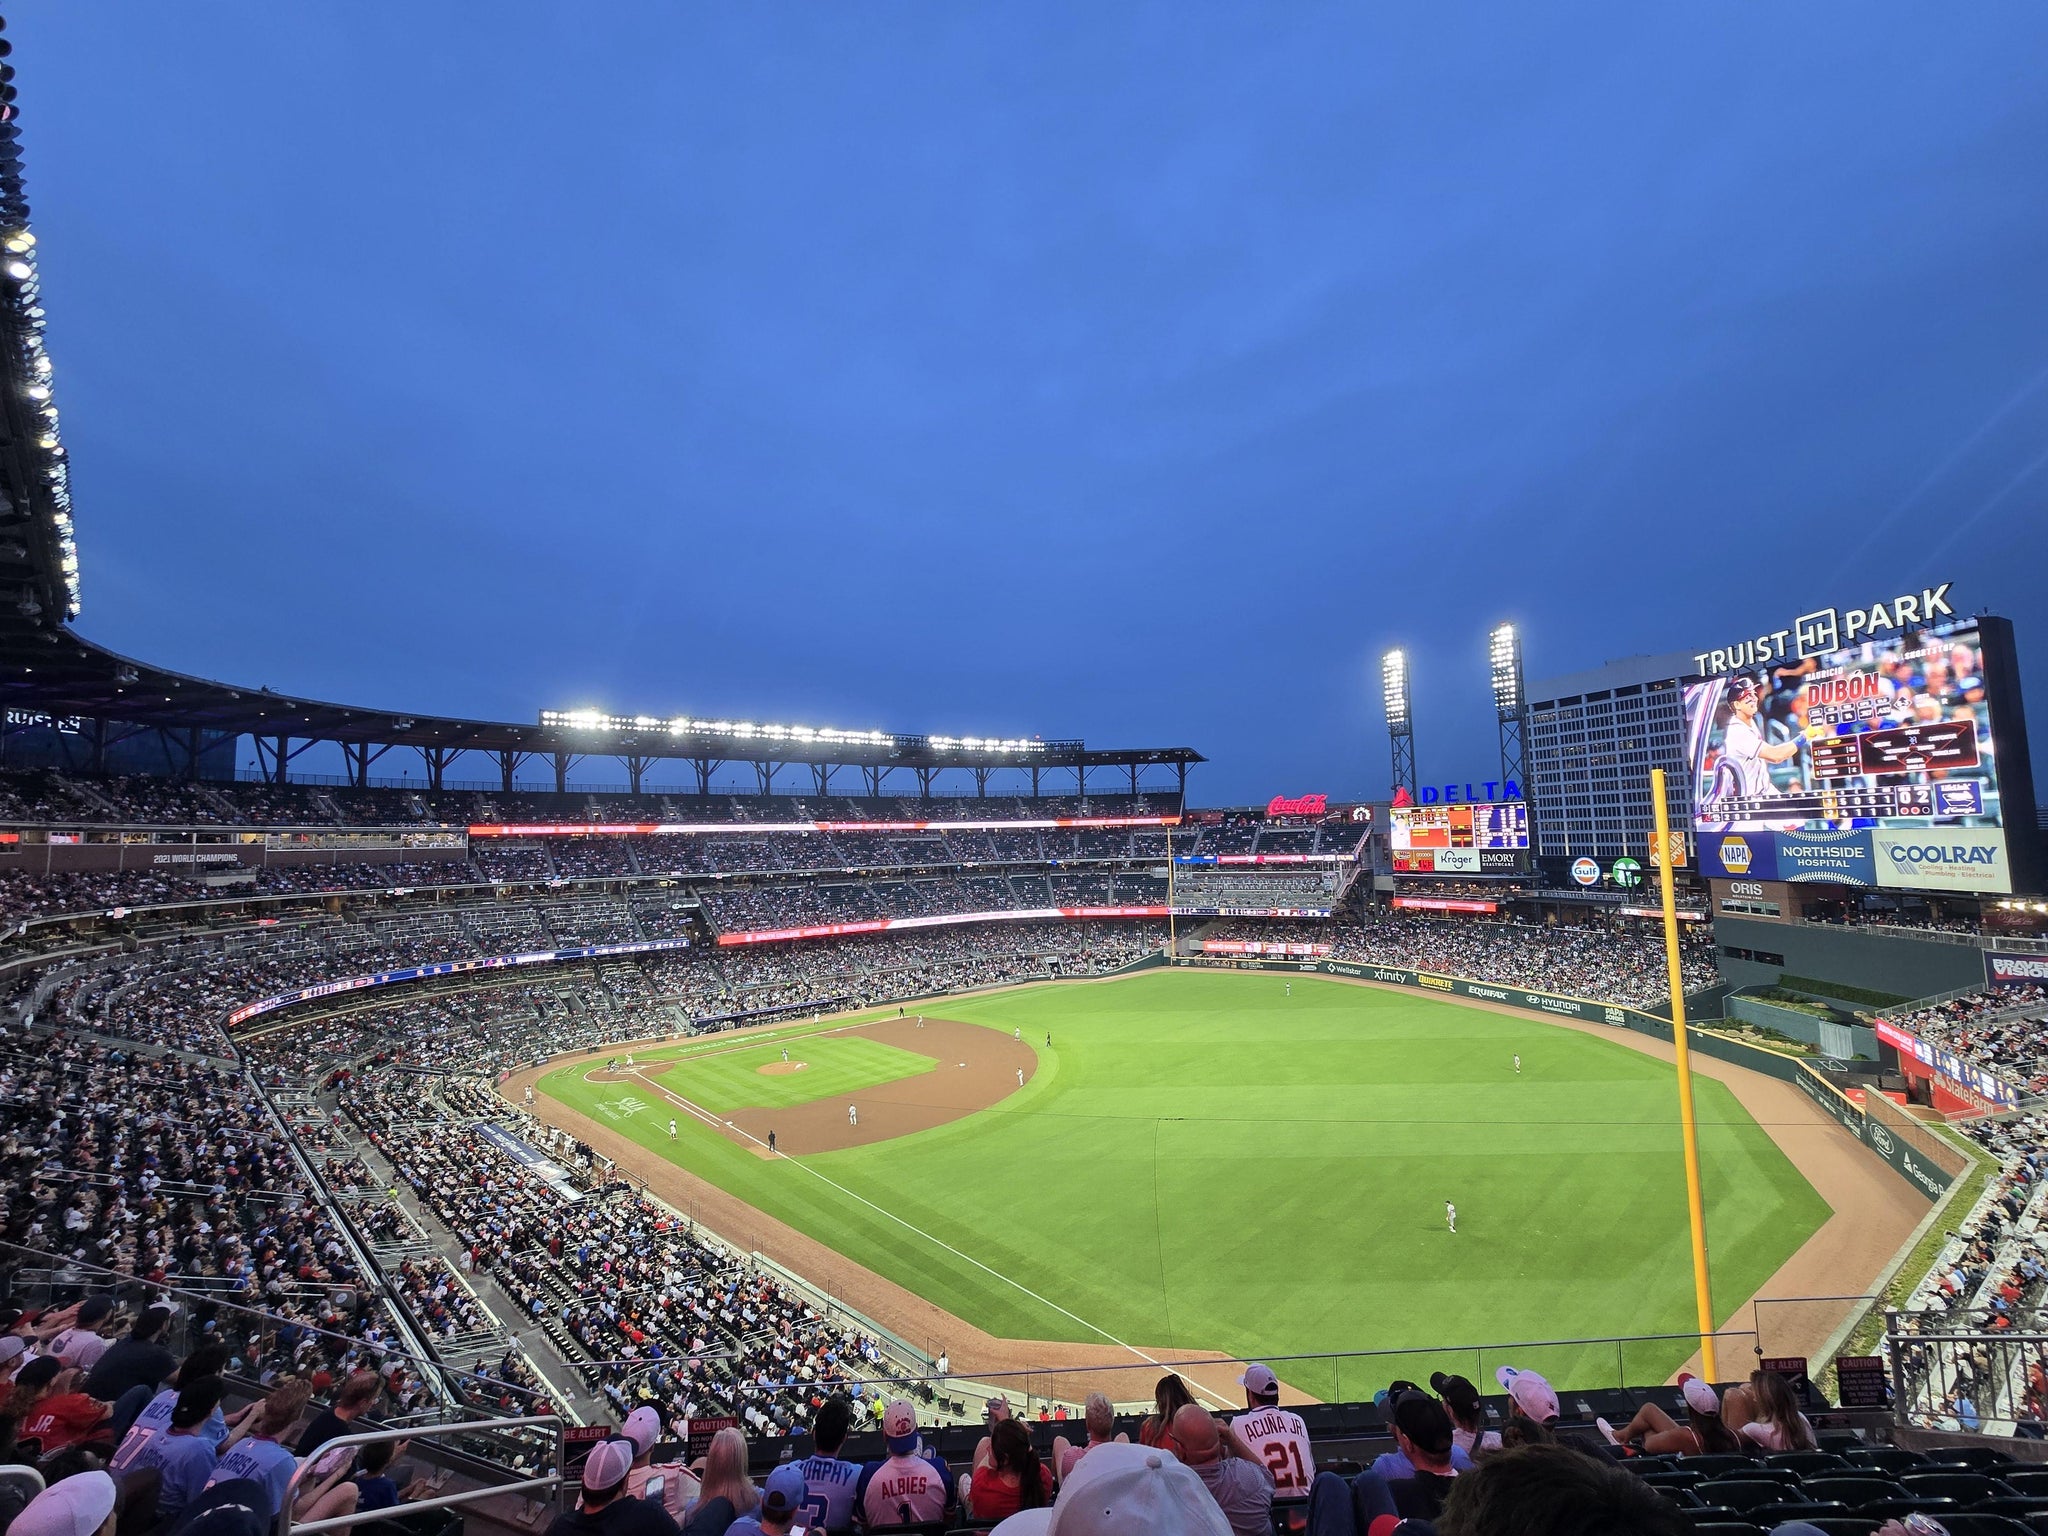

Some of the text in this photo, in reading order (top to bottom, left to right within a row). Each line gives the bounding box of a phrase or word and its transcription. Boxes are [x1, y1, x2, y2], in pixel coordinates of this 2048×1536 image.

[1694, 583, 1953, 677] TRUIST PARK
[1808, 669, 1880, 707] DUBÓN
[1422, 780, 1522, 804] DELTA
[1917, 790, 1929, 803] 2
[1268, 794, 1328, 815] Coca-Cola
[153, 853, 238, 863] 2021 WORLD CHAMPIONS
[1441, 851, 1472, 869] Kroger
[1481, 853, 1515, 862] EMORY
[1723, 846, 1749, 863] NAPA
[1782, 846, 1865, 858] NORTHSIDE
[1890, 845, 1997, 864] COOLRAY
[1574, 866, 1597, 876] Gulf
[1797, 859, 1850, 868] HOSPITAL
[1730, 882, 1763, 896] ORIS
[1336, 965, 1362, 976] Wellstar
[1373, 969, 1407, 984] xfinity
[1418, 974, 1453, 988] QUIKRETE
[1468, 985, 1508, 1000] EQUIFAX
[1541, 997, 1581, 1012] HYUNDAI
[1605, 1007, 1625, 1017] PAPA
[1873, 1126, 1890, 1151] Ford
[1912, 1163, 1939, 1195] Georgia
[1765, 1360, 1804, 1370] BE ALERT
[1842, 1358, 1879, 1368] CAUTION
[142, 1402, 174, 1422] RILEY
[29, 1414, 55, 1433] JR.
[693, 1419, 733, 1431] CAUTION
[1244, 1413, 1305, 1442] ACUÑA JR.
[564, 1428, 607, 1439] BE ALERT
[109, 1424, 158, 1471] 27
[217, 1452, 251, 1475] ARRIS
[1263, 1440, 1308, 1488] 21
[881, 1476, 928, 1500] ALBIES
[897, 1501, 912, 1524] 1
